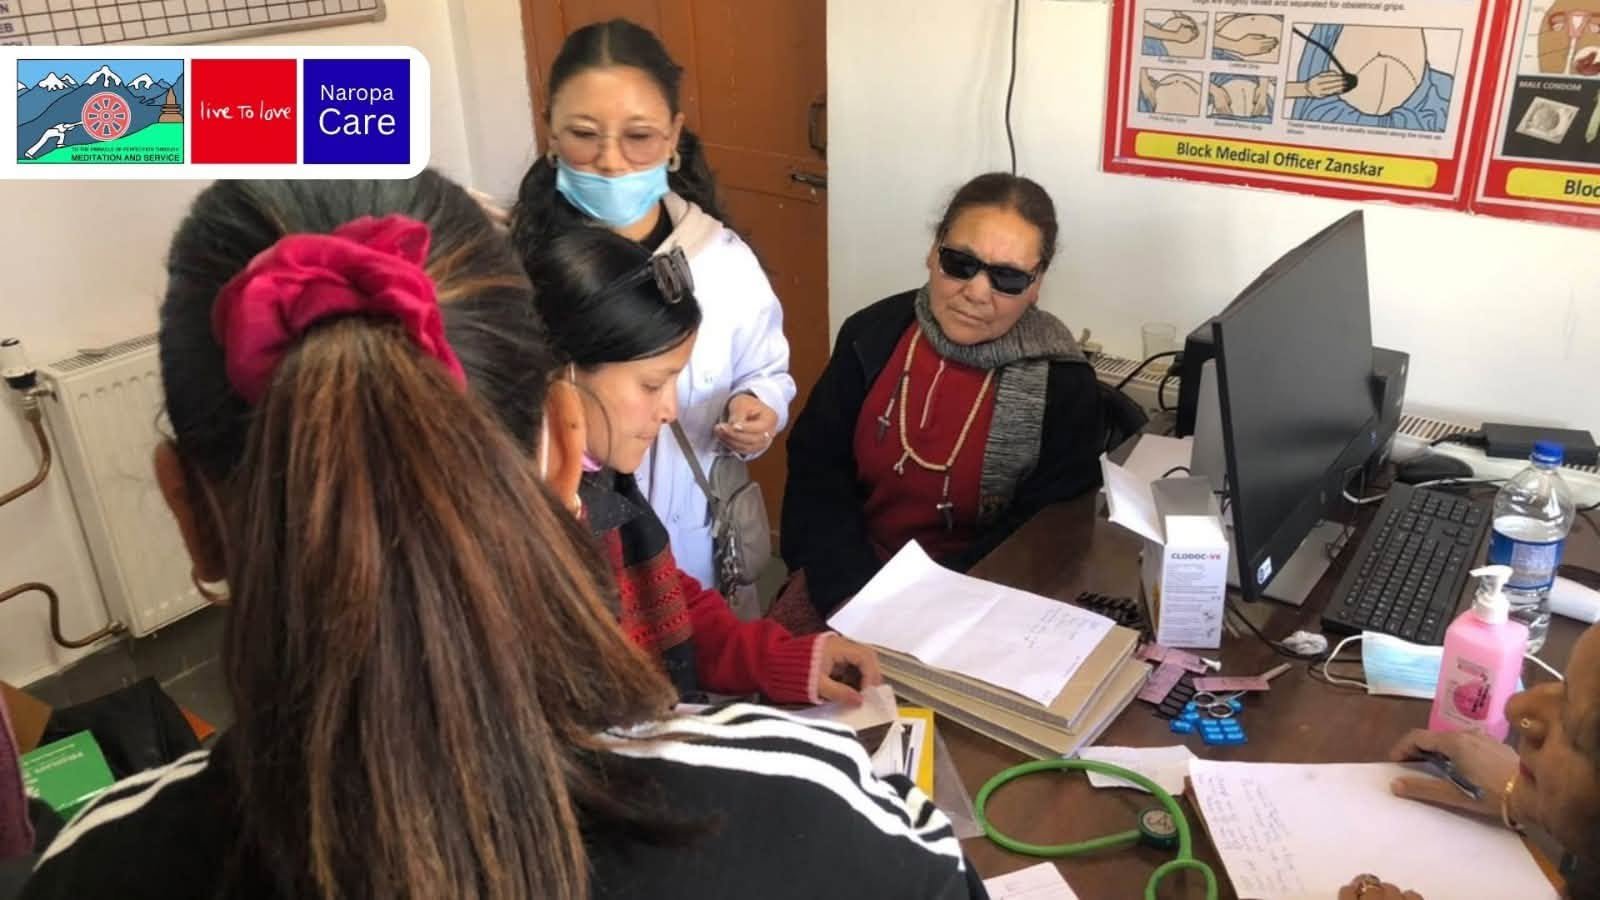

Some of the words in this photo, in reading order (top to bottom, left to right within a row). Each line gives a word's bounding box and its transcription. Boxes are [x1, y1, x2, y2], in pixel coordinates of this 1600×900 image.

[1519, 80, 1541, 89] MALE
[1543, 82, 1582, 91] CONDOM
[1177, 142, 1212, 158] Block
[1216, 146, 1269, 165] Medical
[1273, 152, 1321, 170] Officer
[1325, 158, 1385, 177] Zanskar
[1564, 179, 1600, 198] Bloc
